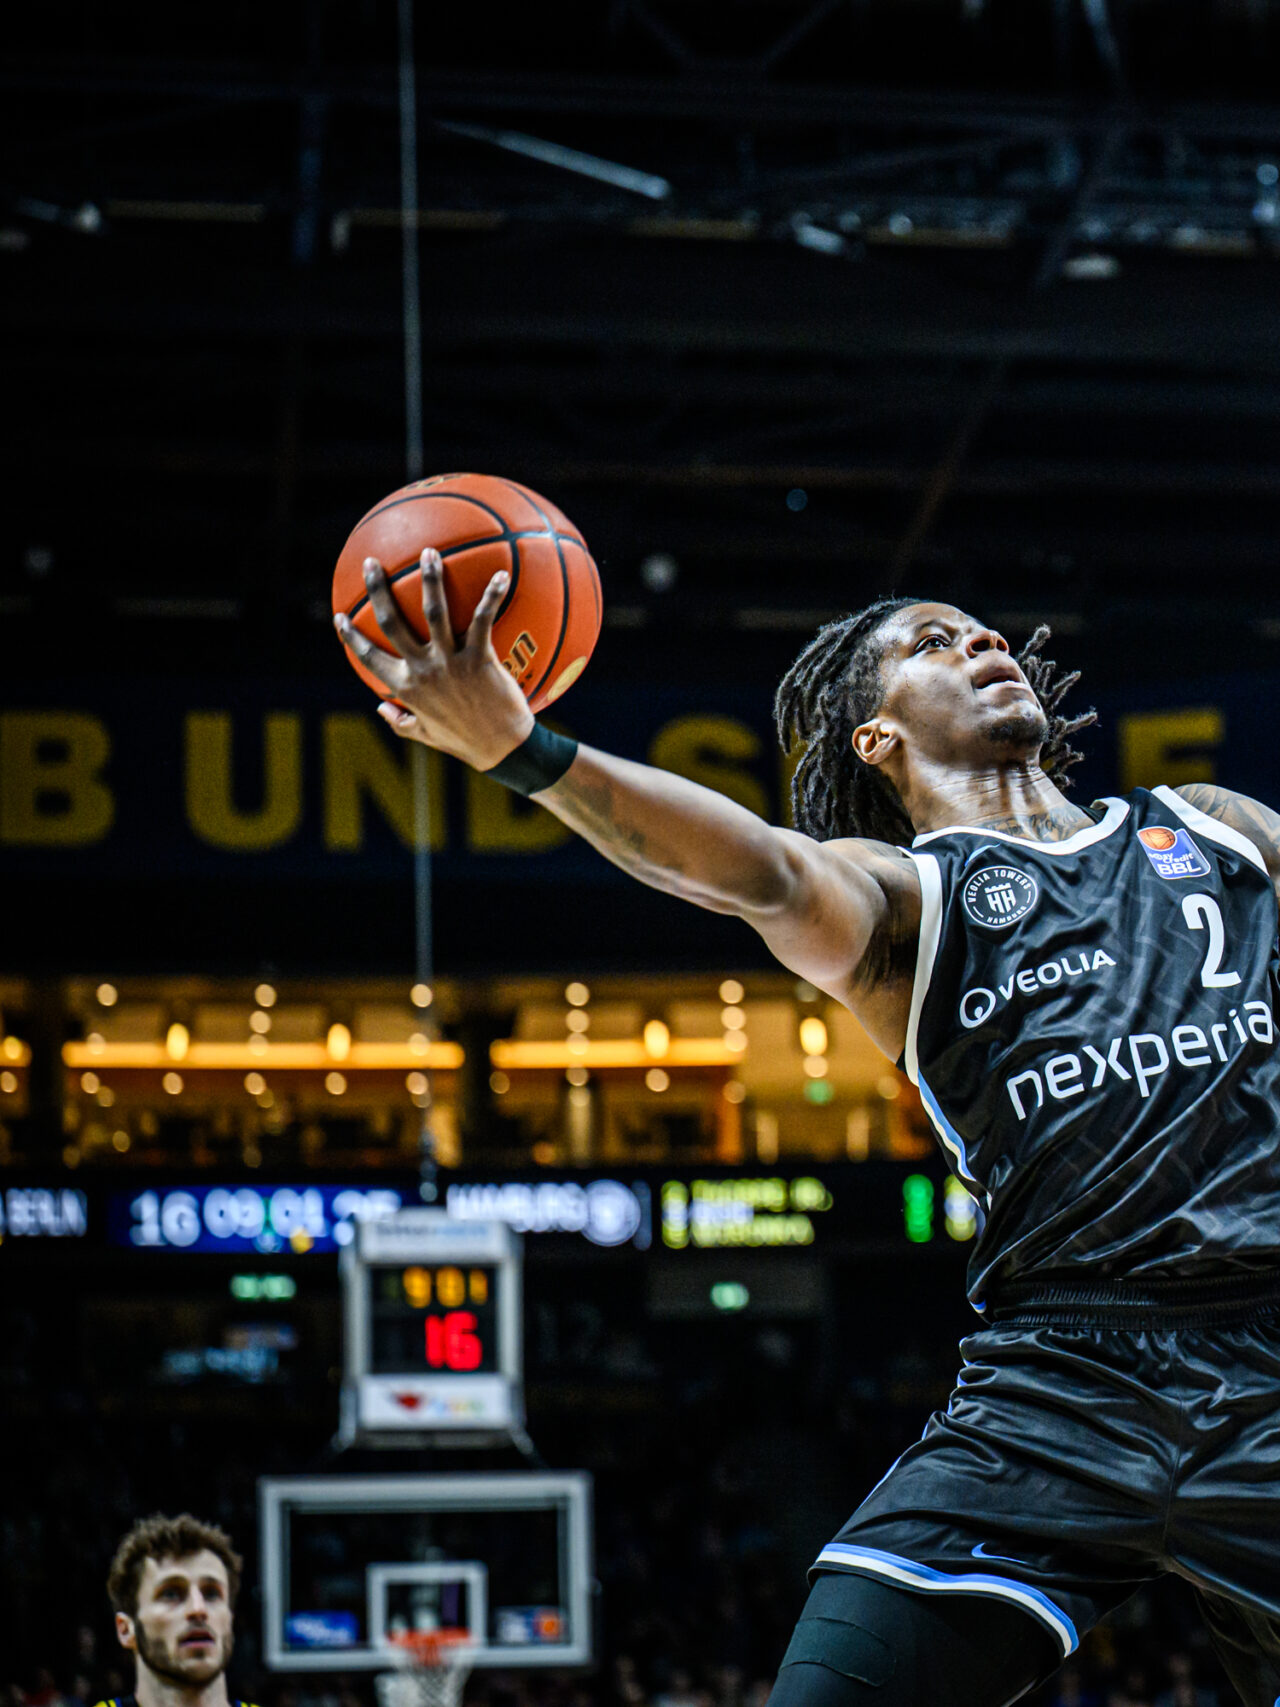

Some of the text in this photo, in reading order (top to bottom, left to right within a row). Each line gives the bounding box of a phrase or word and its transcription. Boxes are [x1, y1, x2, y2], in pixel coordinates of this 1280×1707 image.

[967, 869, 1032, 903] VEOLIA TOWERS
[1157, 860, 1202, 875] BBL
[1181, 893, 1242, 989] 2
[998, 948, 1117, 1001] VEOLIA
[1006, 1000, 1275, 1121] nexperia
[425, 1310, 484, 1371] 16
